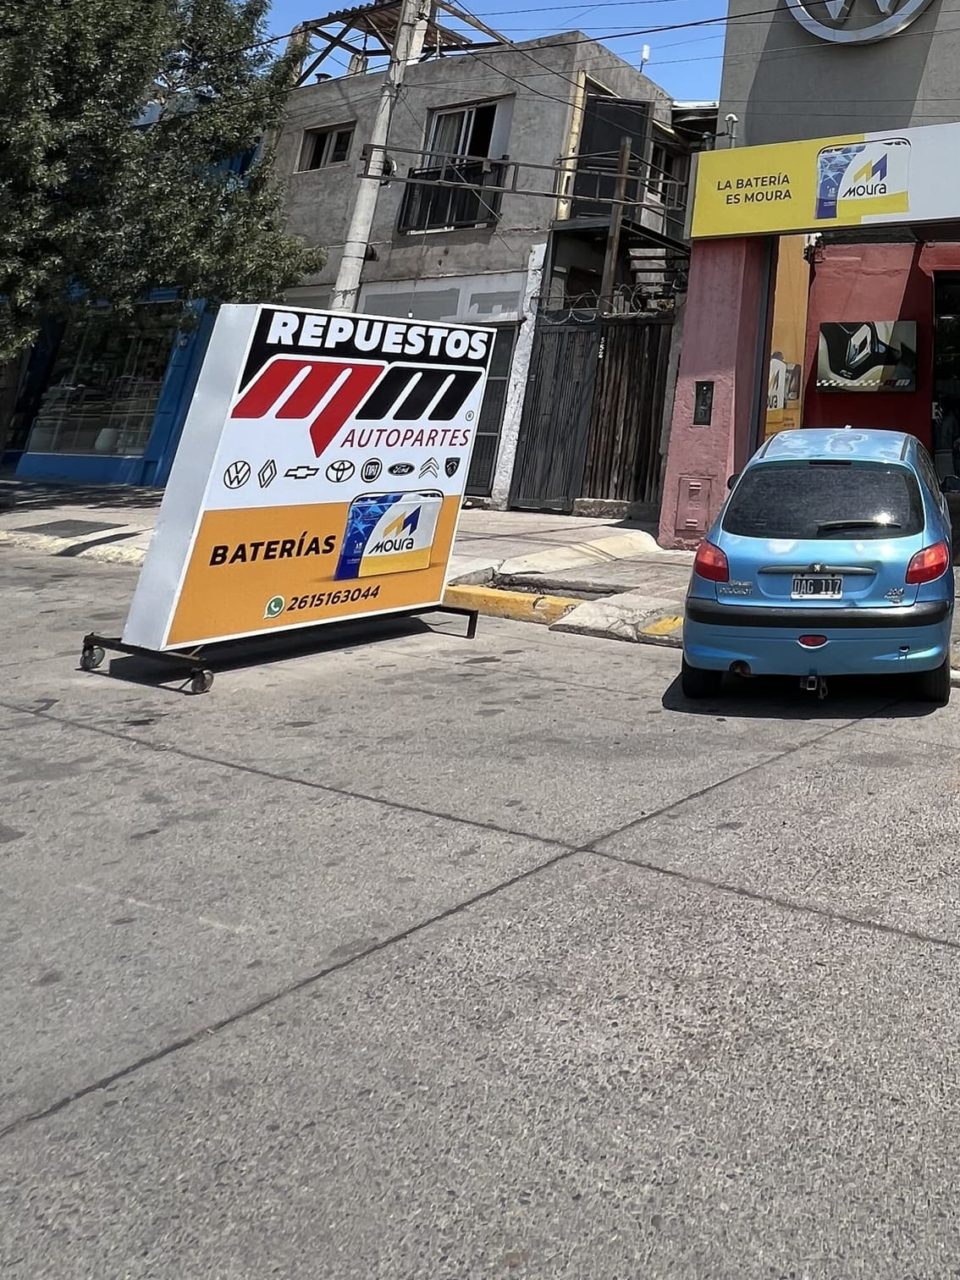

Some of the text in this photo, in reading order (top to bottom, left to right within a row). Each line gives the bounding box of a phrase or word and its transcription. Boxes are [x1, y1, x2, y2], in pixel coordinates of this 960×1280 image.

[717, 172, 790, 191] LA BATERÍA
[726, 189, 792, 205] ES MOURA
[265, 311, 489, 360] REPUESTOS
[340, 428, 471, 448] AUTOPARTES
[209, 530, 337, 566] BATERÍAS
[793, 579, 841, 595] DAG 117
[286, 585, 381, 612] 2615163044
